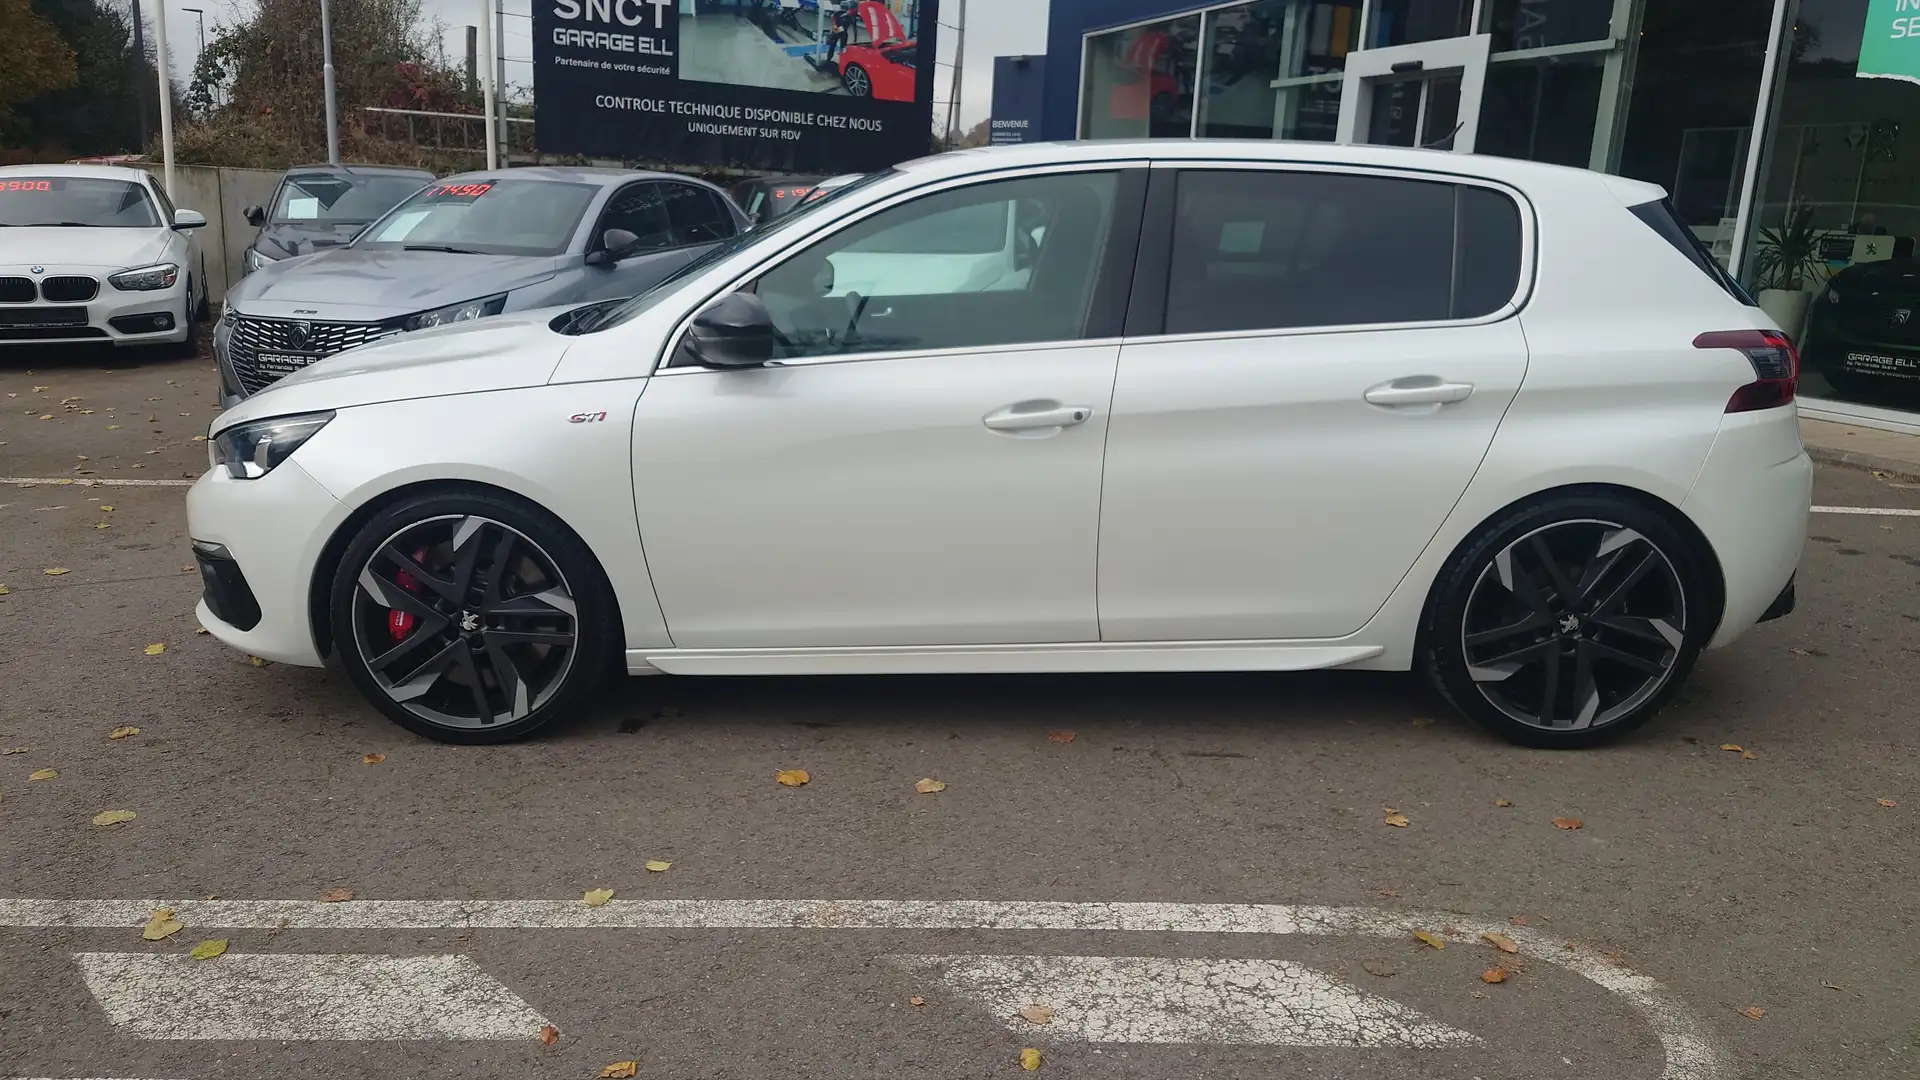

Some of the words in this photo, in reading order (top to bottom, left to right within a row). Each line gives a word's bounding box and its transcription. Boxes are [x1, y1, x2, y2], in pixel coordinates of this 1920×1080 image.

[553, 0, 672, 29] SNCT
[553, 28, 635, 53] GARAGE
[638, 36, 673, 56] ELL
[555, 56, 599, 69] Partenaire
[601, 61, 612, 70] de
[613, 63, 635, 72] votre
[637, 65, 671, 76] sécurité
[595, 95, 665, 113] CONTROLE
[668, 101, 741, 119] TECHNIQUE
[744, 107, 815, 126] DISPONIBLE
[816, 114, 847, 129] CHEZ
[849, 118, 883, 132] NOUS
[688, 122, 758, 137] UNIQUEMENT
[760, 128, 779, 139] SUR
[781, 130, 801, 140] RDV
[992, 120, 1029, 129] BIENVENUE
[426, 184, 492, 197] 17490
[258, 353, 305, 365] GARAGE
[1847, 353, 1894, 365] GARAGE
[1895, 358, 1917, 368] ELL
